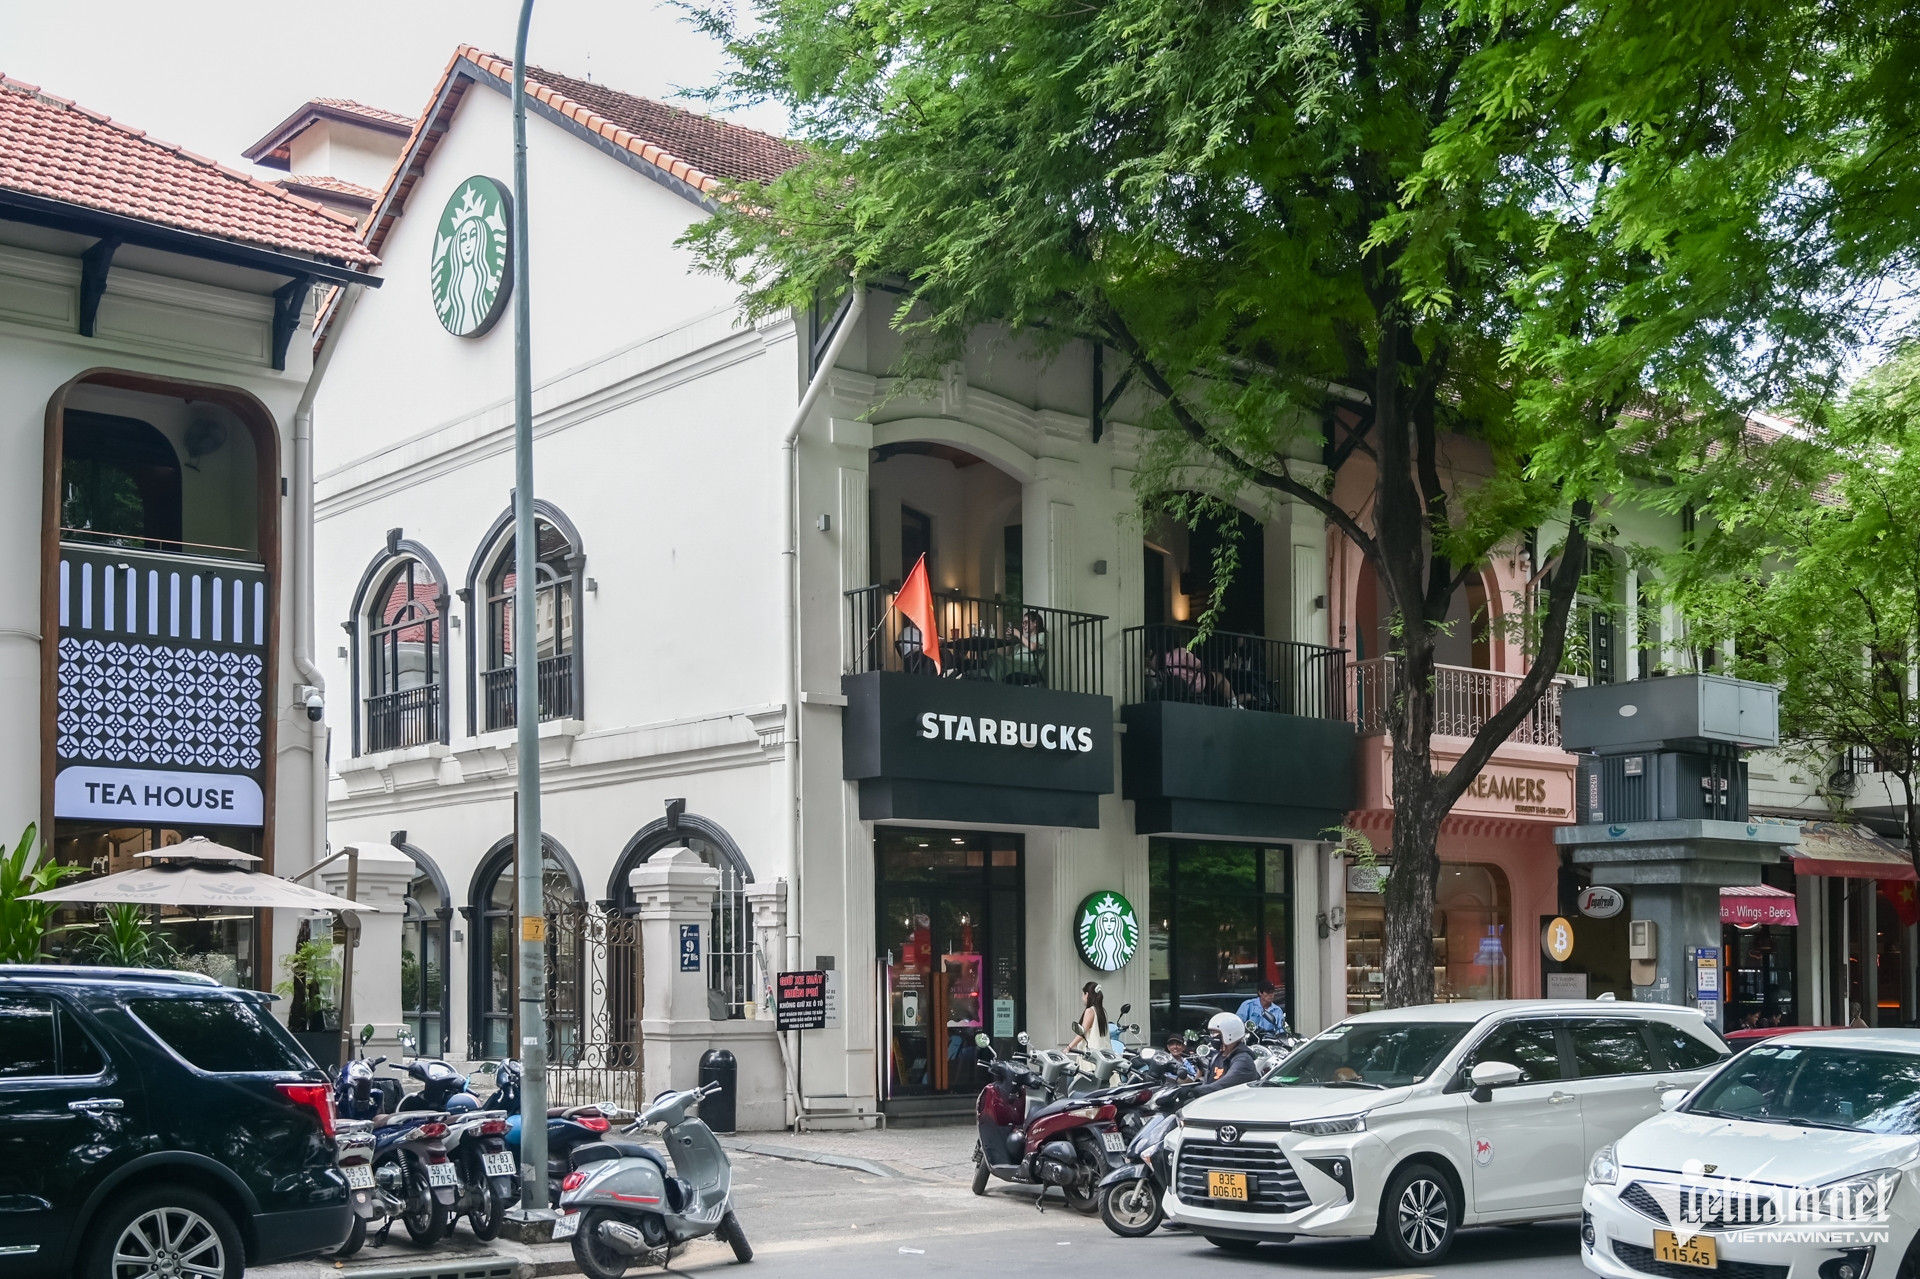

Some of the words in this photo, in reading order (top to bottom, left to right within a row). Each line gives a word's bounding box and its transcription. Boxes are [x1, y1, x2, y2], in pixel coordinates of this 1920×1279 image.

[921, 712, 1093, 752] STARBUCKS
[1467, 774, 1546, 802] REAMERS
[85, 782, 137, 806] TEA
[144, 785, 234, 810] HOUSE
[1584, 893, 1615, 910] Segafredo
[1736, 905, 1762, 920] Wings
[1769, 906, 1791, 918] Beers
[534, 926, 540, 934] 7
[682, 926, 689, 937] 7
[686, 940, 694, 952] 9
[795, 976, 804, 985] XE
[488, 1153, 509, 1164] 47-B3
[345, 1166, 368, 1178] 59-S3
[487, 1163, 513, 1174] 119.36
[351, 1177, 373, 1188] 52.51
[1219, 1174, 1235, 1185] 83E
[1213, 1185, 1243, 1198] 006.03
[1663, 1247, 1710, 1266] 115.45
